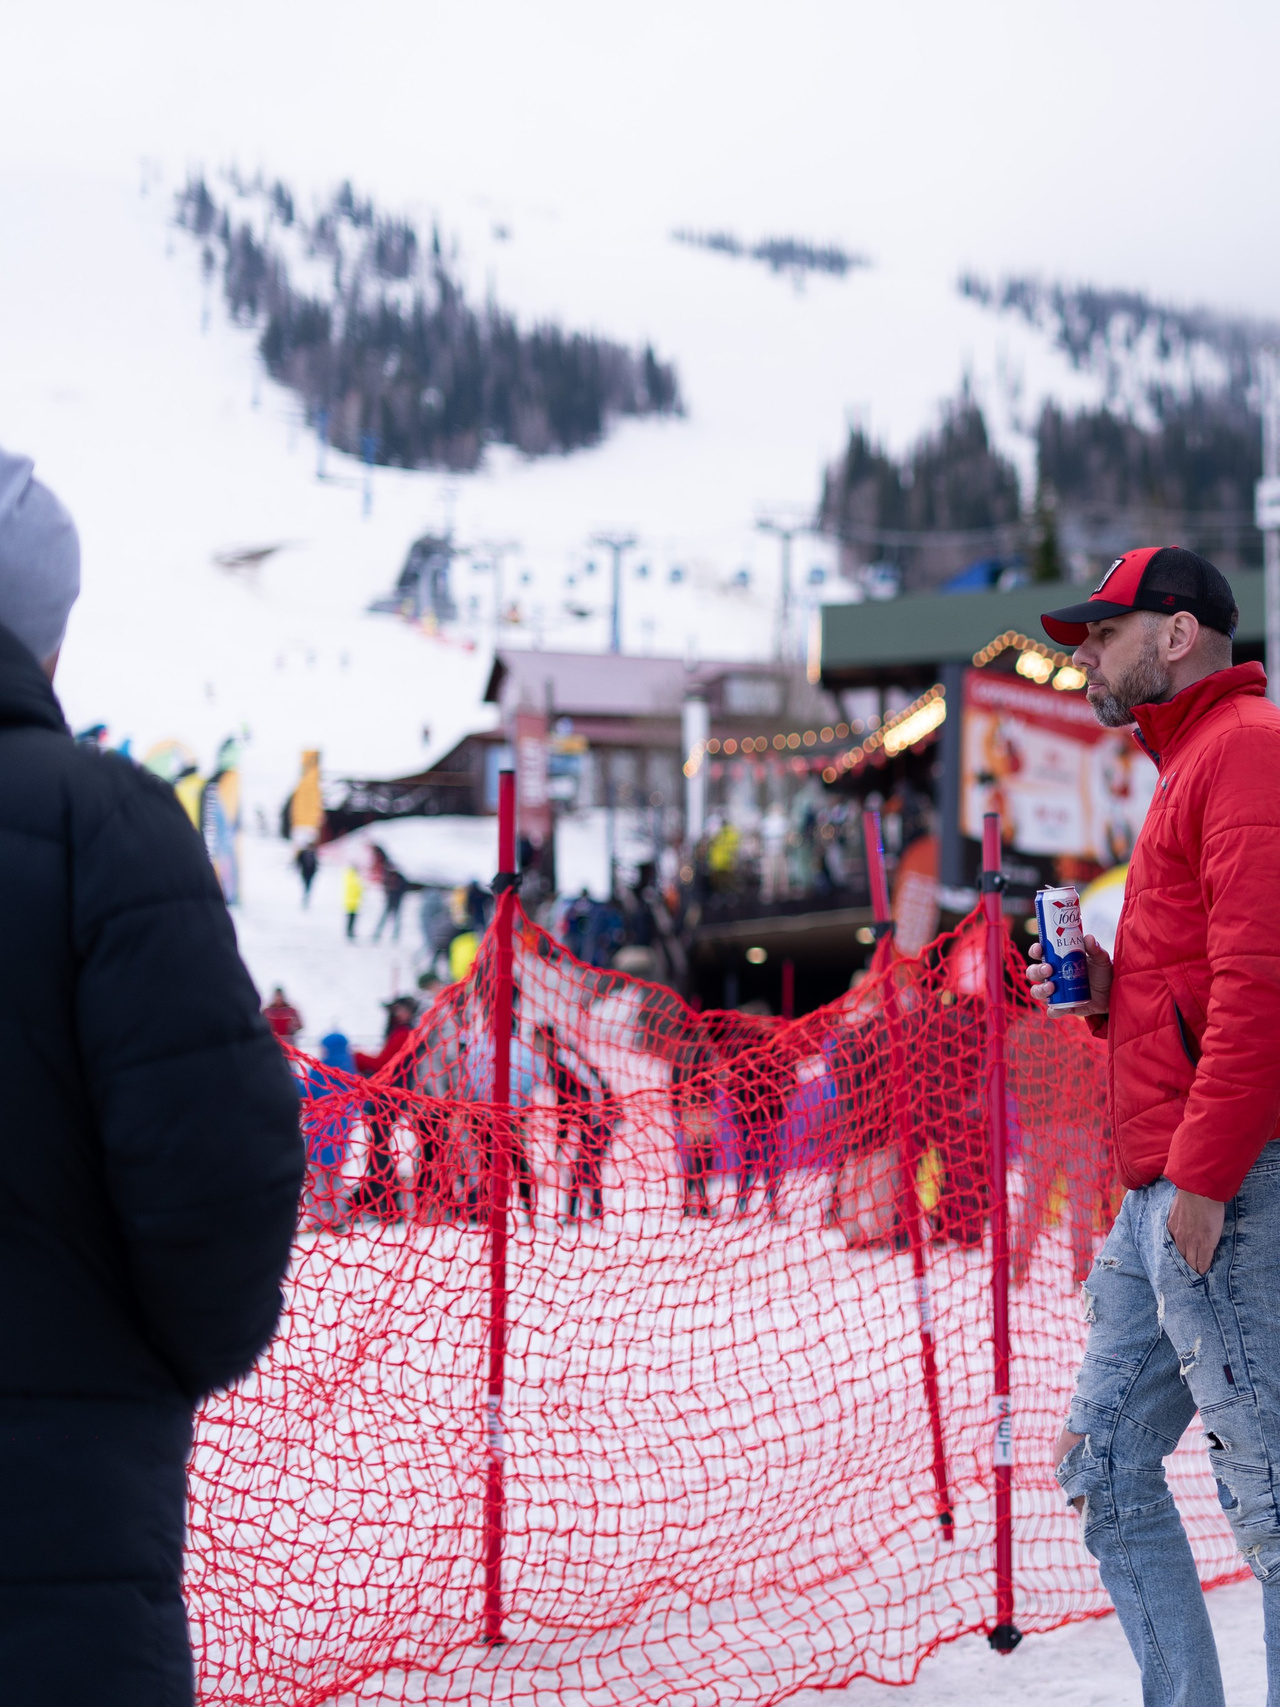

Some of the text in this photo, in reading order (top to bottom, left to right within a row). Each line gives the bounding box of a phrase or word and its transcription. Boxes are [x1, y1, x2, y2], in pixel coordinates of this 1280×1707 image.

[1059, 910, 1081, 924] 1664
[1057, 936, 1084, 947] BLAN
[997, 1401, 1011, 1457] SET
